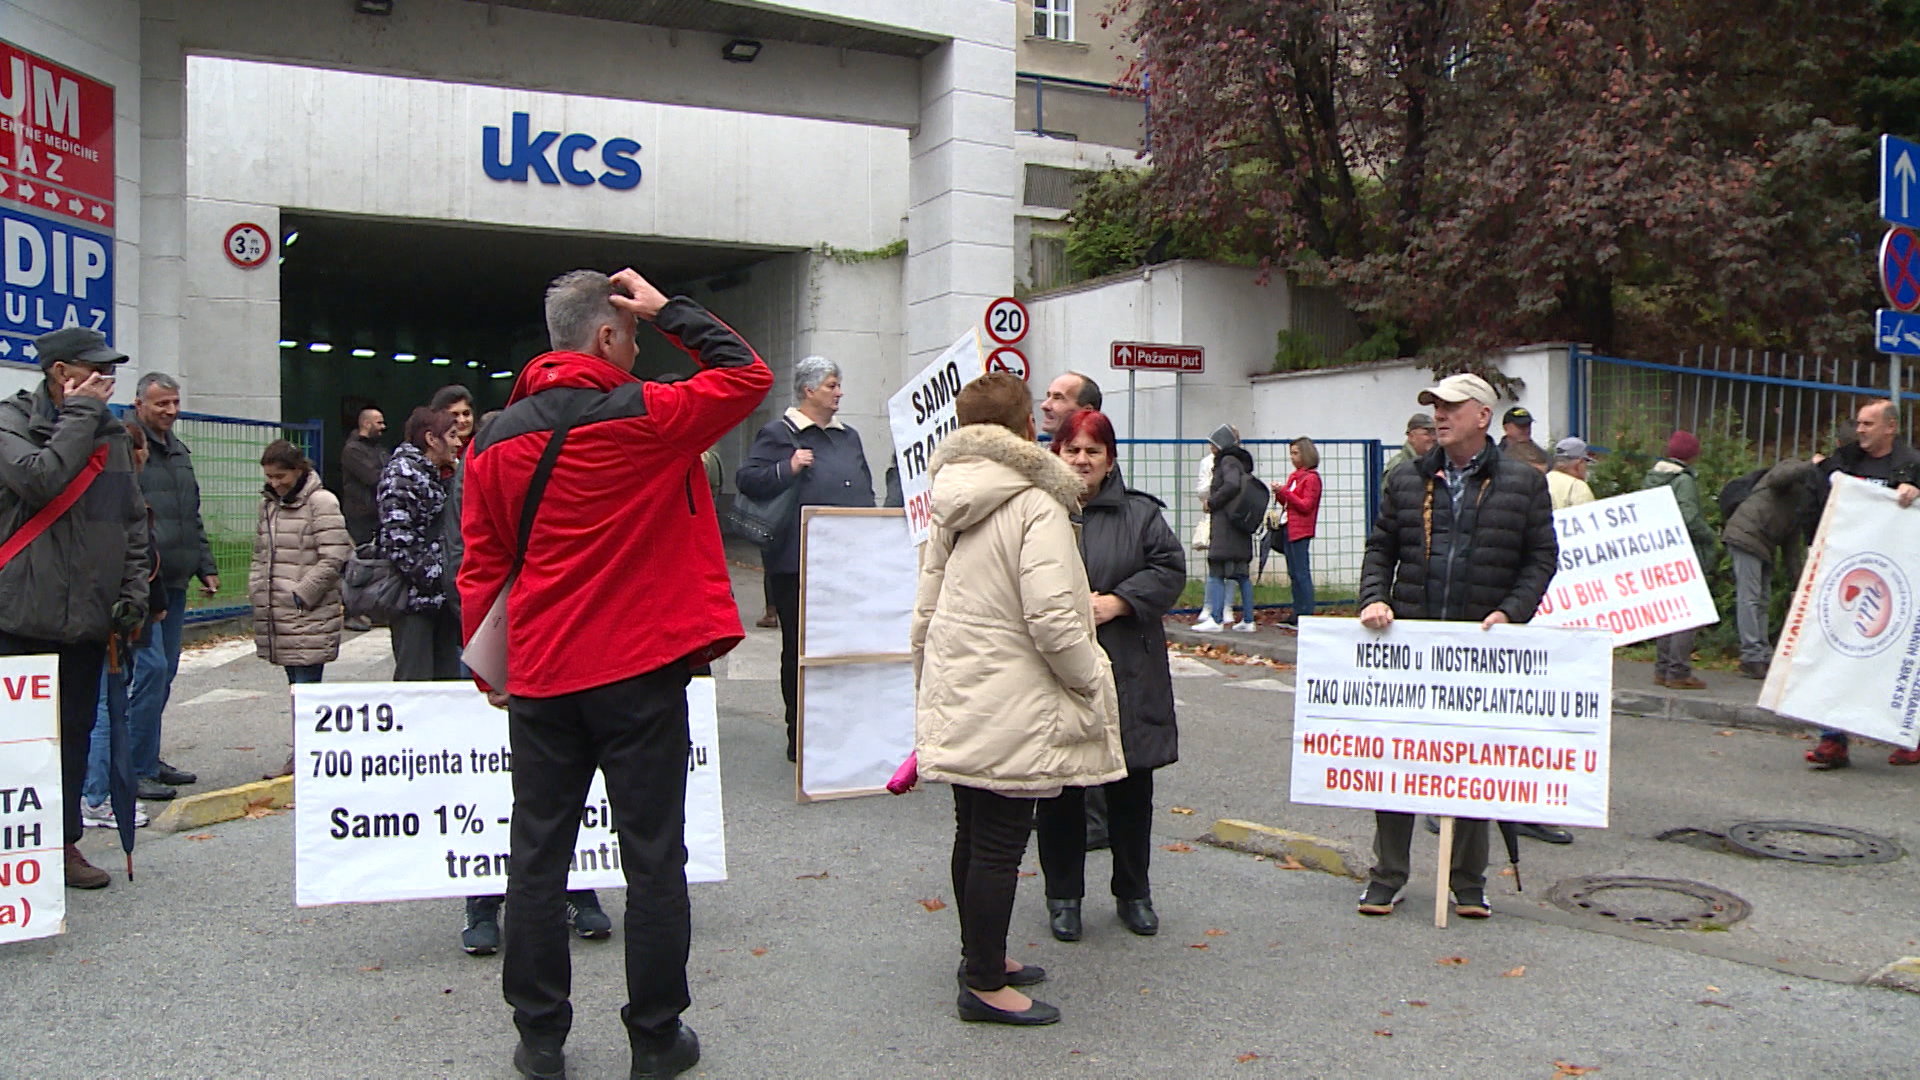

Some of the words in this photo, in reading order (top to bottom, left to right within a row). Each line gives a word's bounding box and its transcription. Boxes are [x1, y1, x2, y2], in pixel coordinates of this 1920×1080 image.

[44, 133, 99, 163] MEDICINE
[483, 111, 642, 190] ukcs
[4, 216, 107, 300] DIP
[235, 235, 246, 254] 3
[5, 291, 106, 337] ULAZ
[995, 309, 1022, 333] 20
[1137, 350, 1179, 366] Požarni
[1181, 354, 1200, 368] put
[911, 361, 962, 426] SAMO
[908, 489, 932, 534] PRA
[1558, 516, 1586, 538] ZA
[1589, 512, 1600, 530] 1
[1605, 503, 1638, 528] SAT
[1556, 586, 1572, 610] U
[1573, 579, 1608, 607] BIH
[1614, 571, 1639, 597] SE
[1640, 558, 1697, 591] UREDI
[1356, 637, 1411, 671] NEĆEMO
[1431, 645, 1548, 676] INOSTRANSTVO!!!
[1307, 678, 1339, 706] TAKO
[1342, 675, 1426, 710] UNIŠTAVAMO
[1430, 684, 1556, 718] TRANSPLANTACIJU
[1561, 690, 1570, 718] U
[1575, 690, 1599, 719] BIH
[314, 703, 404, 733] 2019.
[310, 750, 353, 778] 700
[361, 748, 463, 782] pacijenta
[470, 746, 514, 774] treb
[1303, 729, 1384, 760] HOĆEMO
[1391, 738, 1577, 773] TRANSPLANTACIJE
[1584, 750, 1597, 774] U
[1326, 767, 1384, 793] BOSNI
[1390, 772, 1397, 794] I
[1403, 773, 1538, 805] HERCEGOVINI
[1546, 783, 1568, 806] !!!
[330, 807, 420, 840] Samo
[433, 803, 485, 835] 1%
